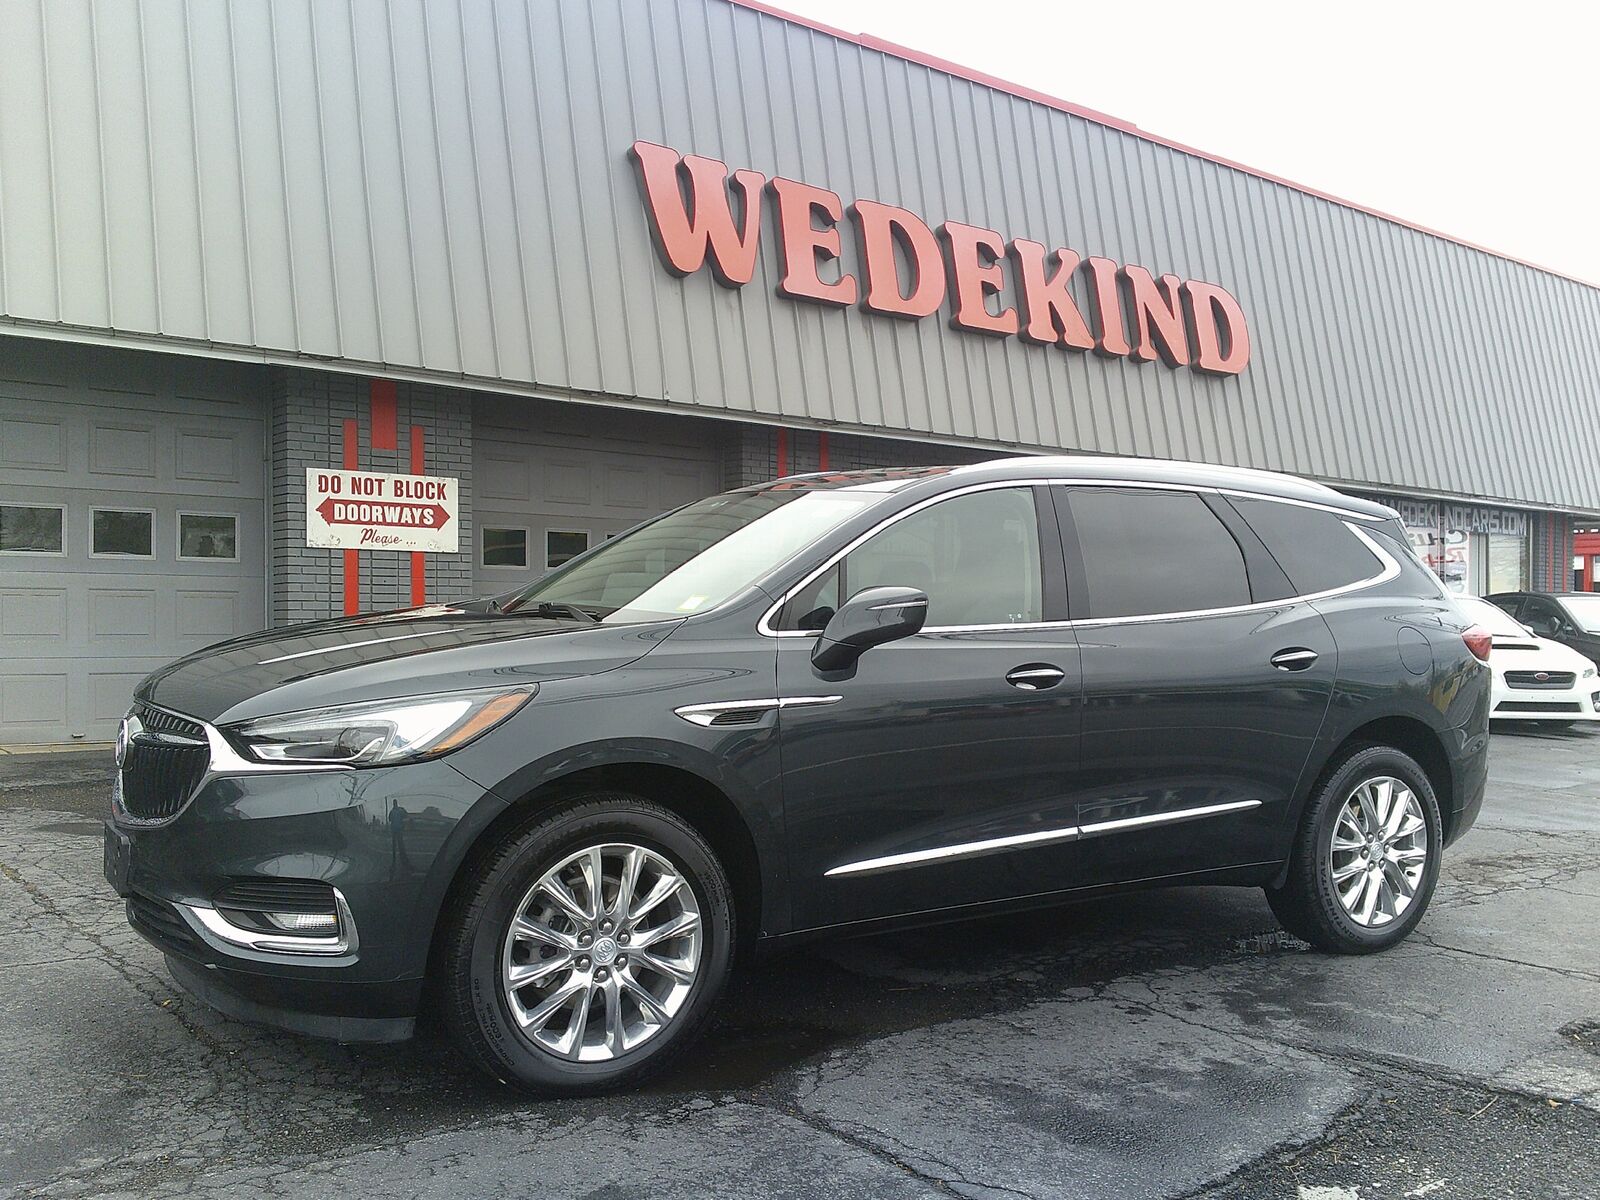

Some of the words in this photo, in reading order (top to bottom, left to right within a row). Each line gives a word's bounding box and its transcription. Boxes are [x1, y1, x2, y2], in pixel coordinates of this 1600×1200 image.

[629, 140, 1251, 378] WEDEKIND
[318, 474, 342, 494] DO
[351, 477, 385, 496] NOT
[394, 480, 447, 500] BLOCK
[334, 503, 434, 525] DOORWAYS
